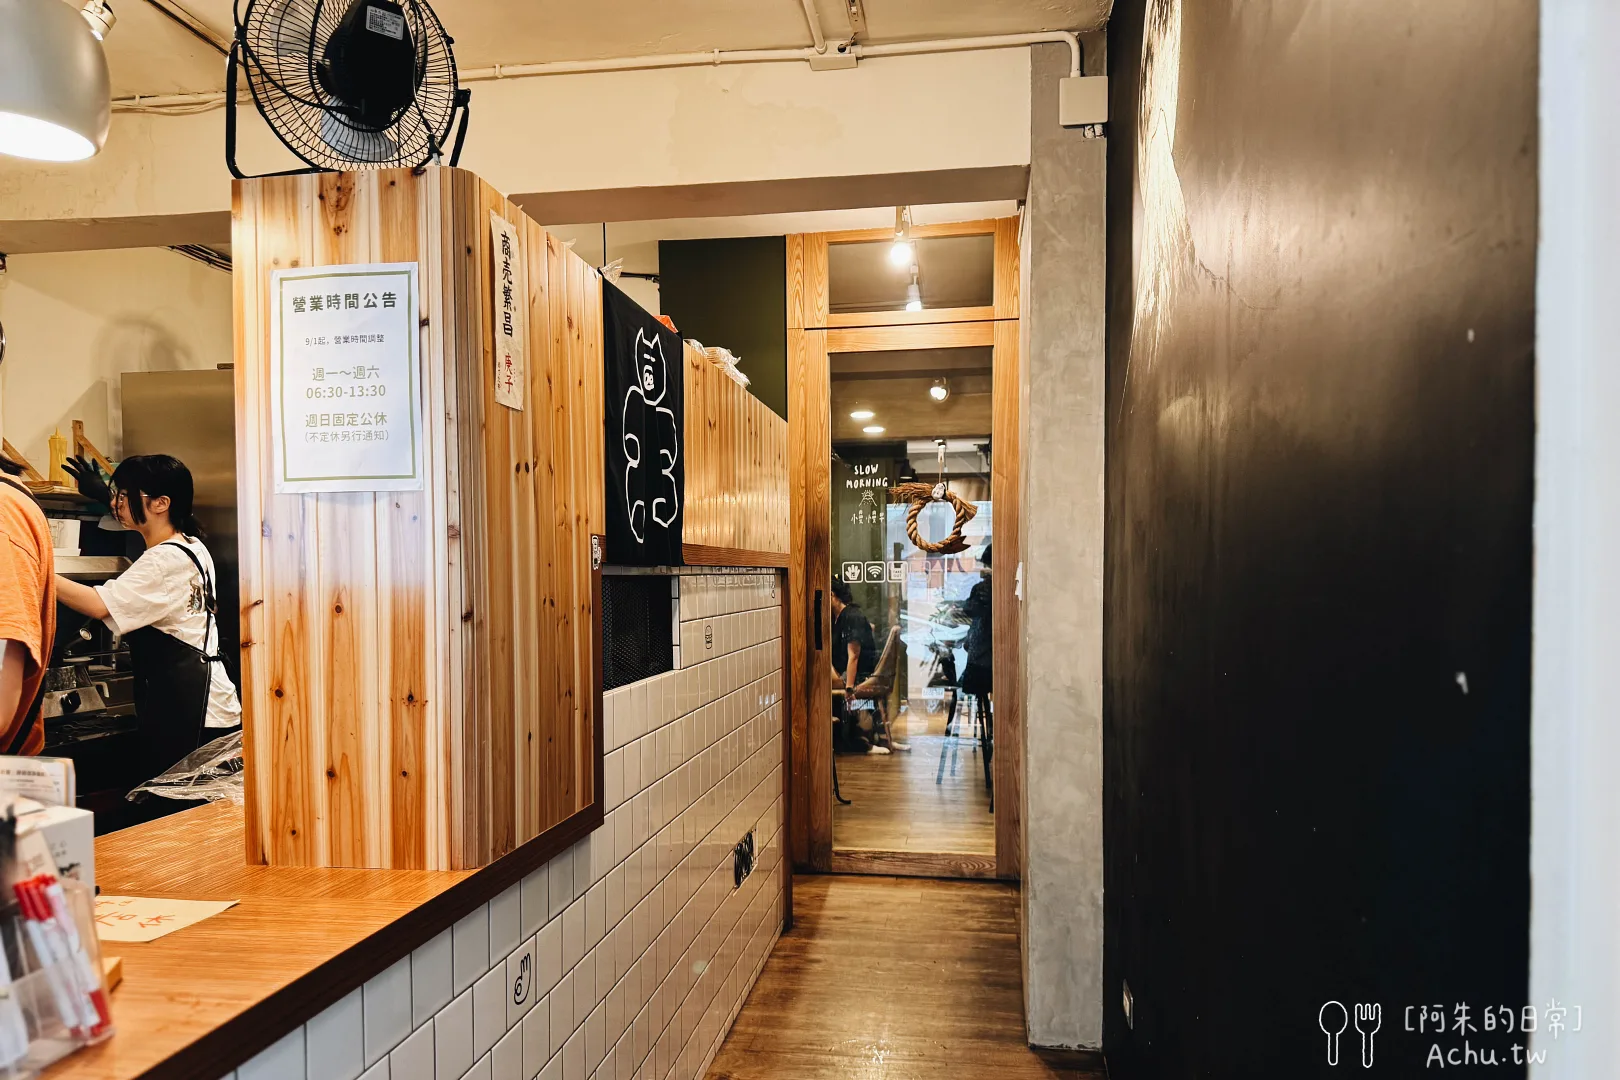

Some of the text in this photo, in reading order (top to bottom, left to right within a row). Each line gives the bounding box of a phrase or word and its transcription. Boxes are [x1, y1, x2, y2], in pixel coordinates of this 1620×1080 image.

[500, 230, 513, 337] 商売繁昌
[292, 291, 397, 313] 營業時間公告
[312, 365, 380, 381] 週一～週六
[306, 384, 386, 399] 06:30-13:30
[305, 412, 388, 428] 週日固定公休
[304, 430, 389, 443] (不定休另行通知)
[854, 463, 879, 475] SLOW
[846, 477, 888, 489] MORNING
